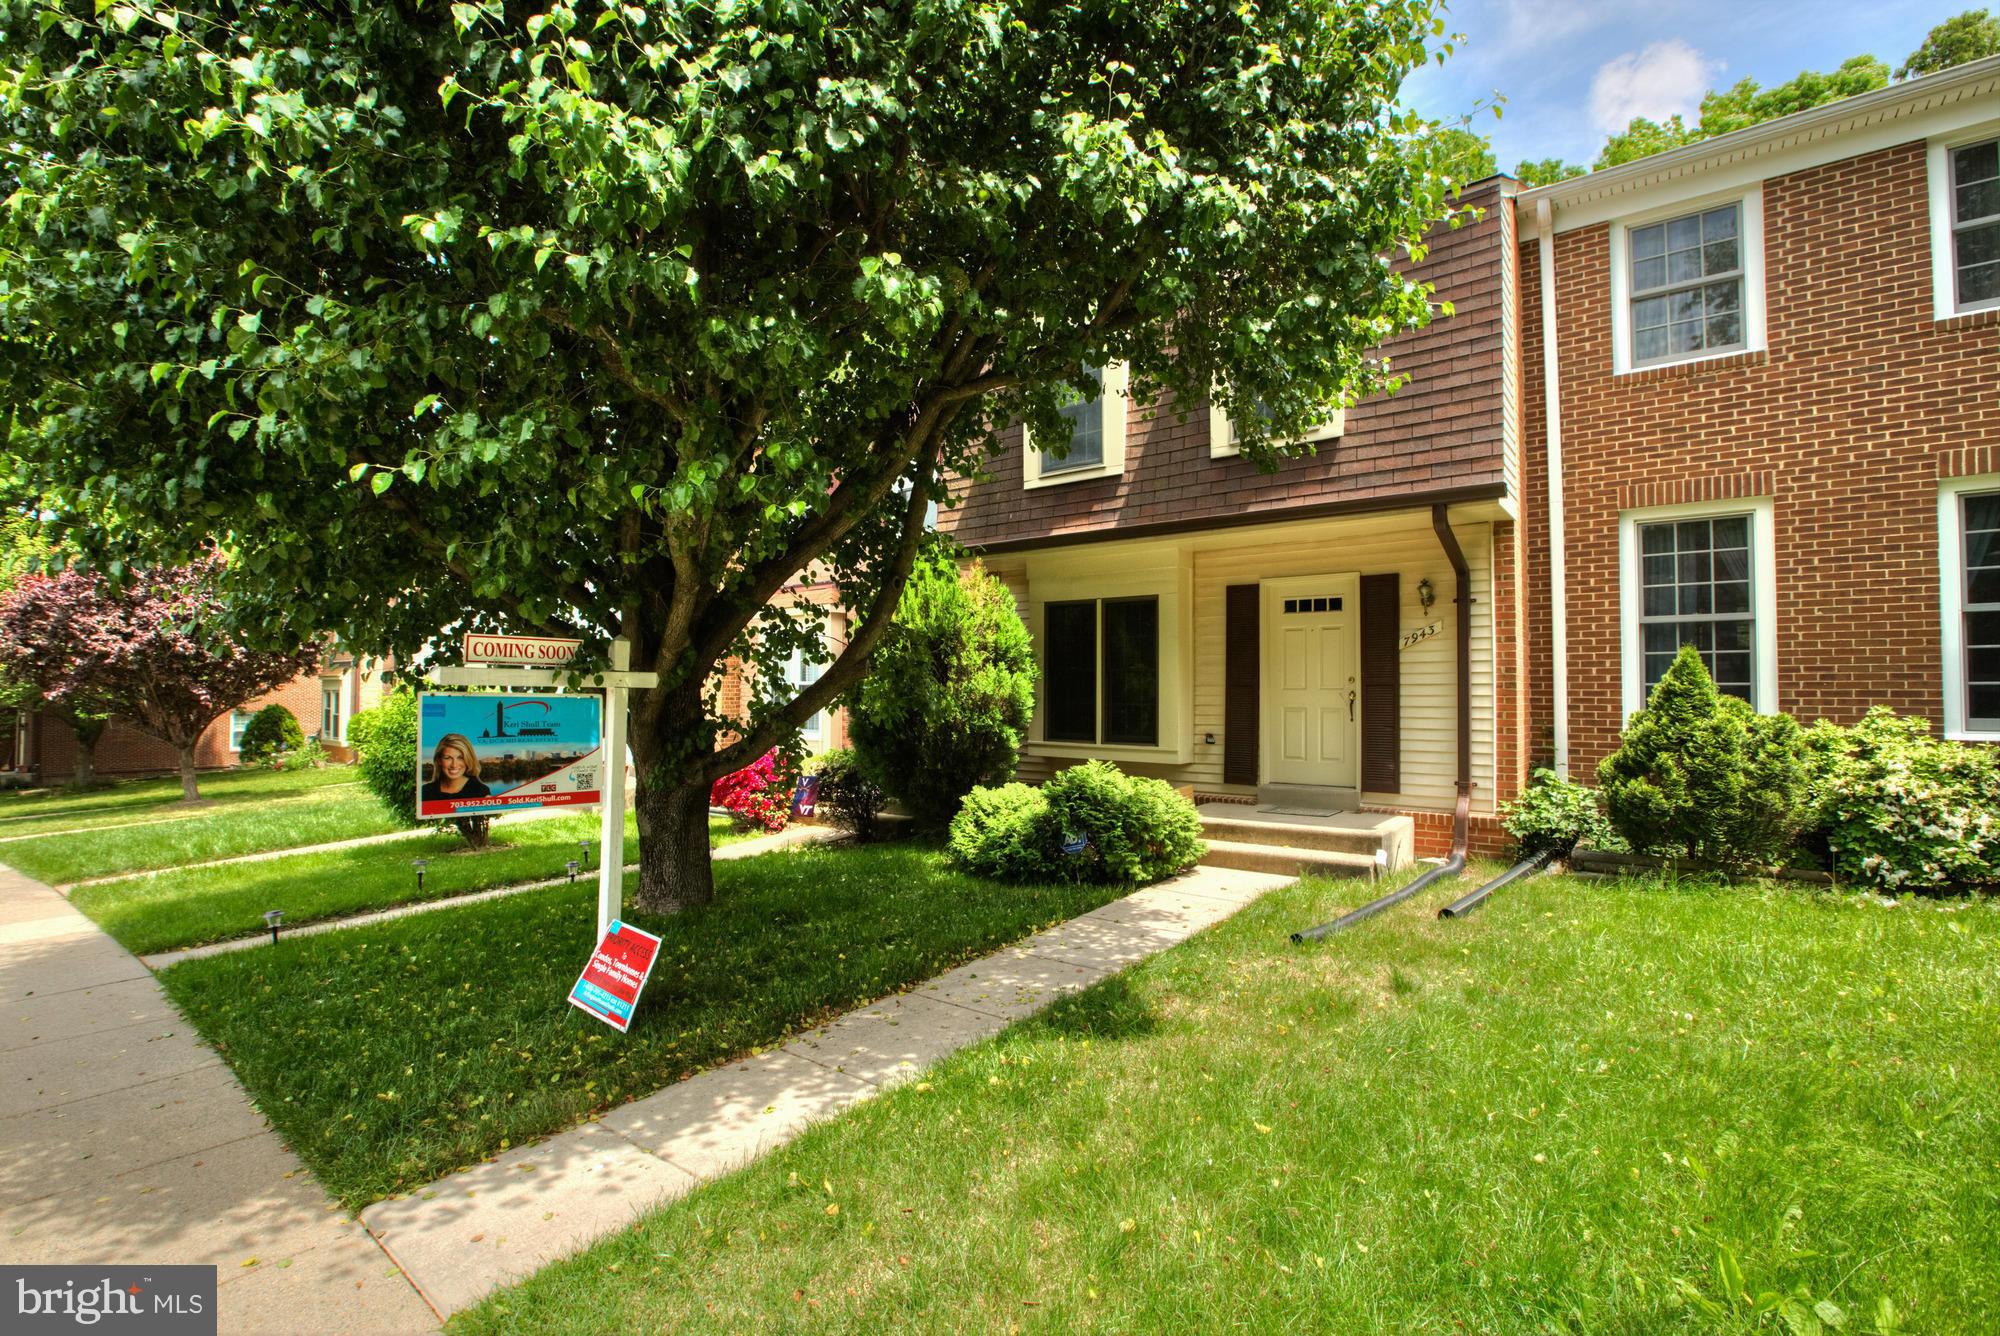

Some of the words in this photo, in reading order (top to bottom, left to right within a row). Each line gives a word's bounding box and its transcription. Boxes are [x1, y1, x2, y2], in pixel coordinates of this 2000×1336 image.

[1404, 625, 1435, 647] 7943
[473, 642, 534, 659] COMING
[538, 644, 575, 660] SOON
[504, 720, 519, 728] Keri
[521, 720, 540, 728] Shull
[542, 720, 561, 728] Team
[450, 799, 502, 808] 703.952.SOLD
[508, 795, 571, 805] Sold.KeriShull.com
